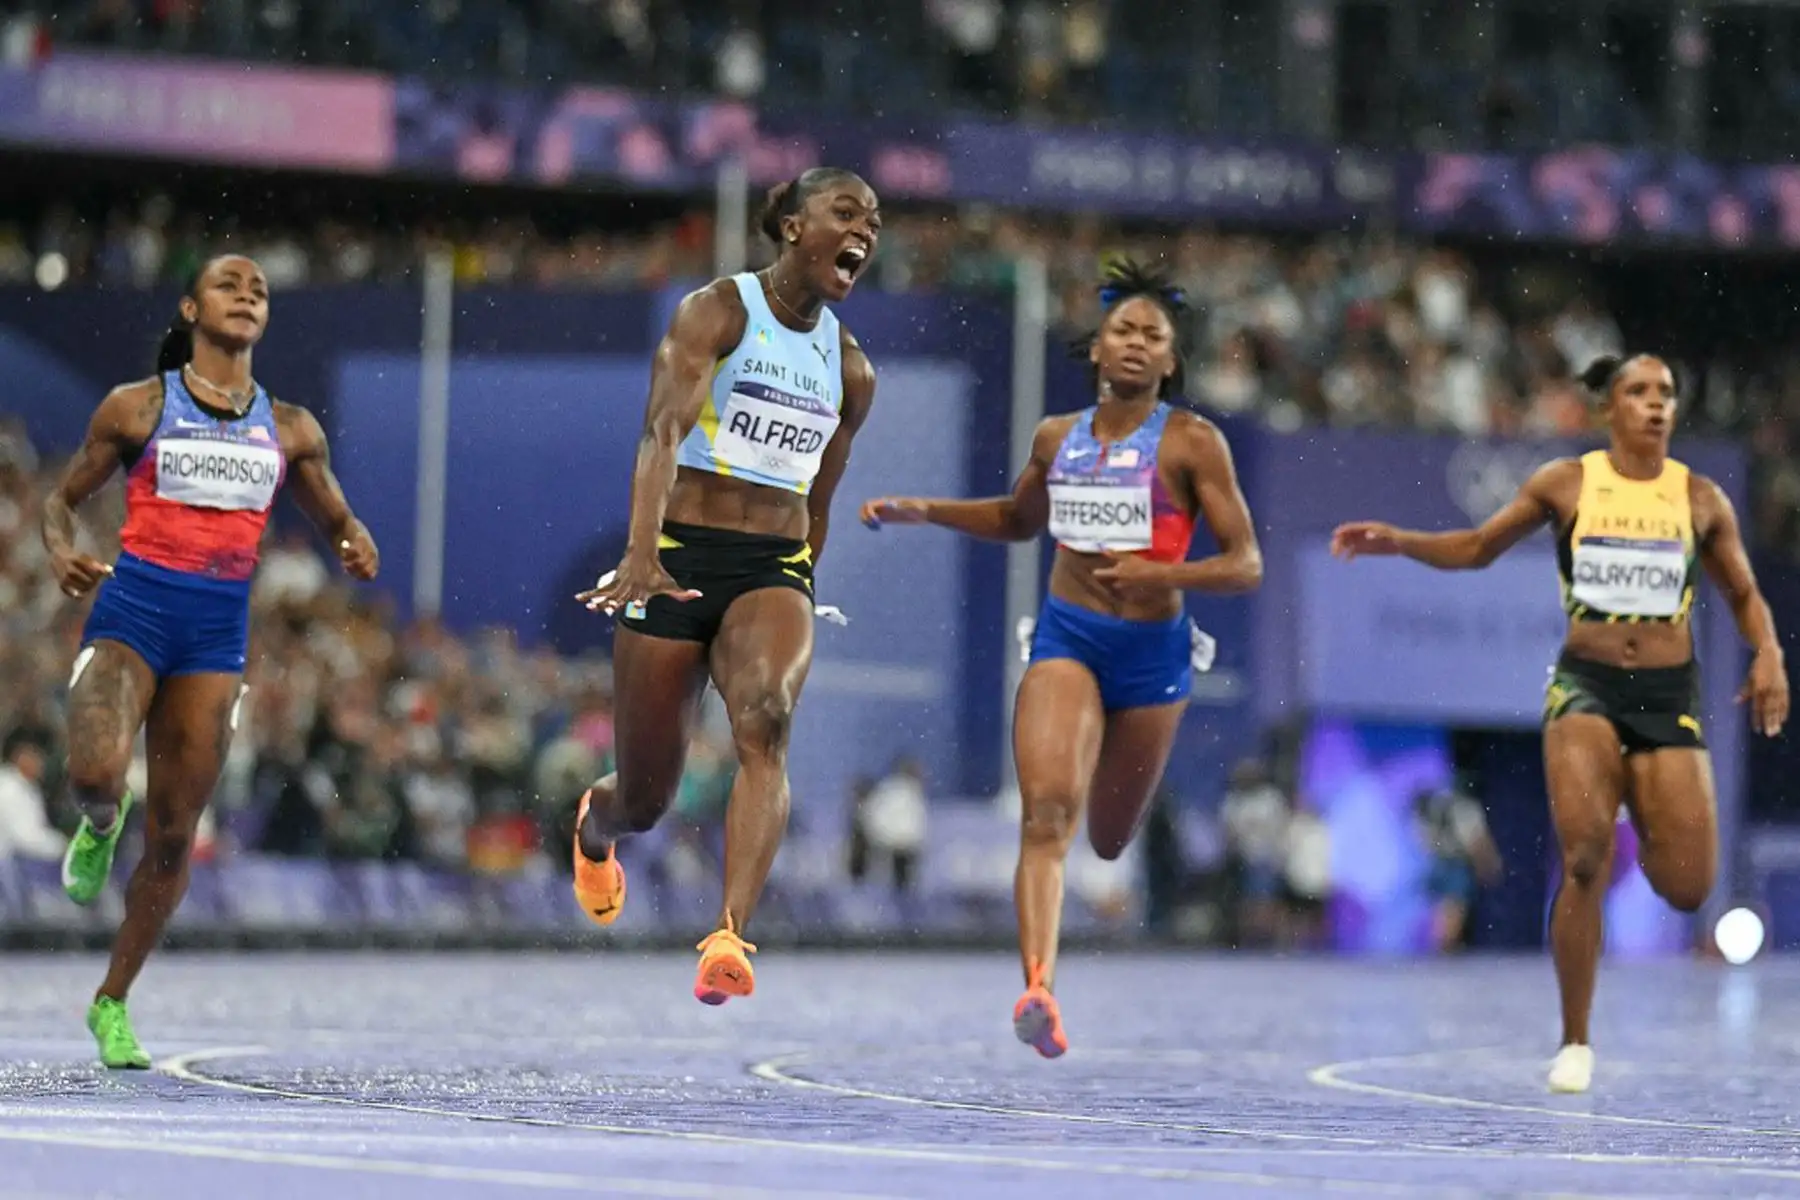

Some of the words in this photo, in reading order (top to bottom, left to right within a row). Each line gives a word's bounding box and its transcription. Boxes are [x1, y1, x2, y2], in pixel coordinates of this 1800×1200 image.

[743, 359, 787, 381] SAINT
[729, 411, 824, 454] ALFRED
[162, 451, 276, 485] RICHARDSON
[1053, 500, 1148, 526] EFFERSON
[1576, 560, 1681, 591] CLAYTON
